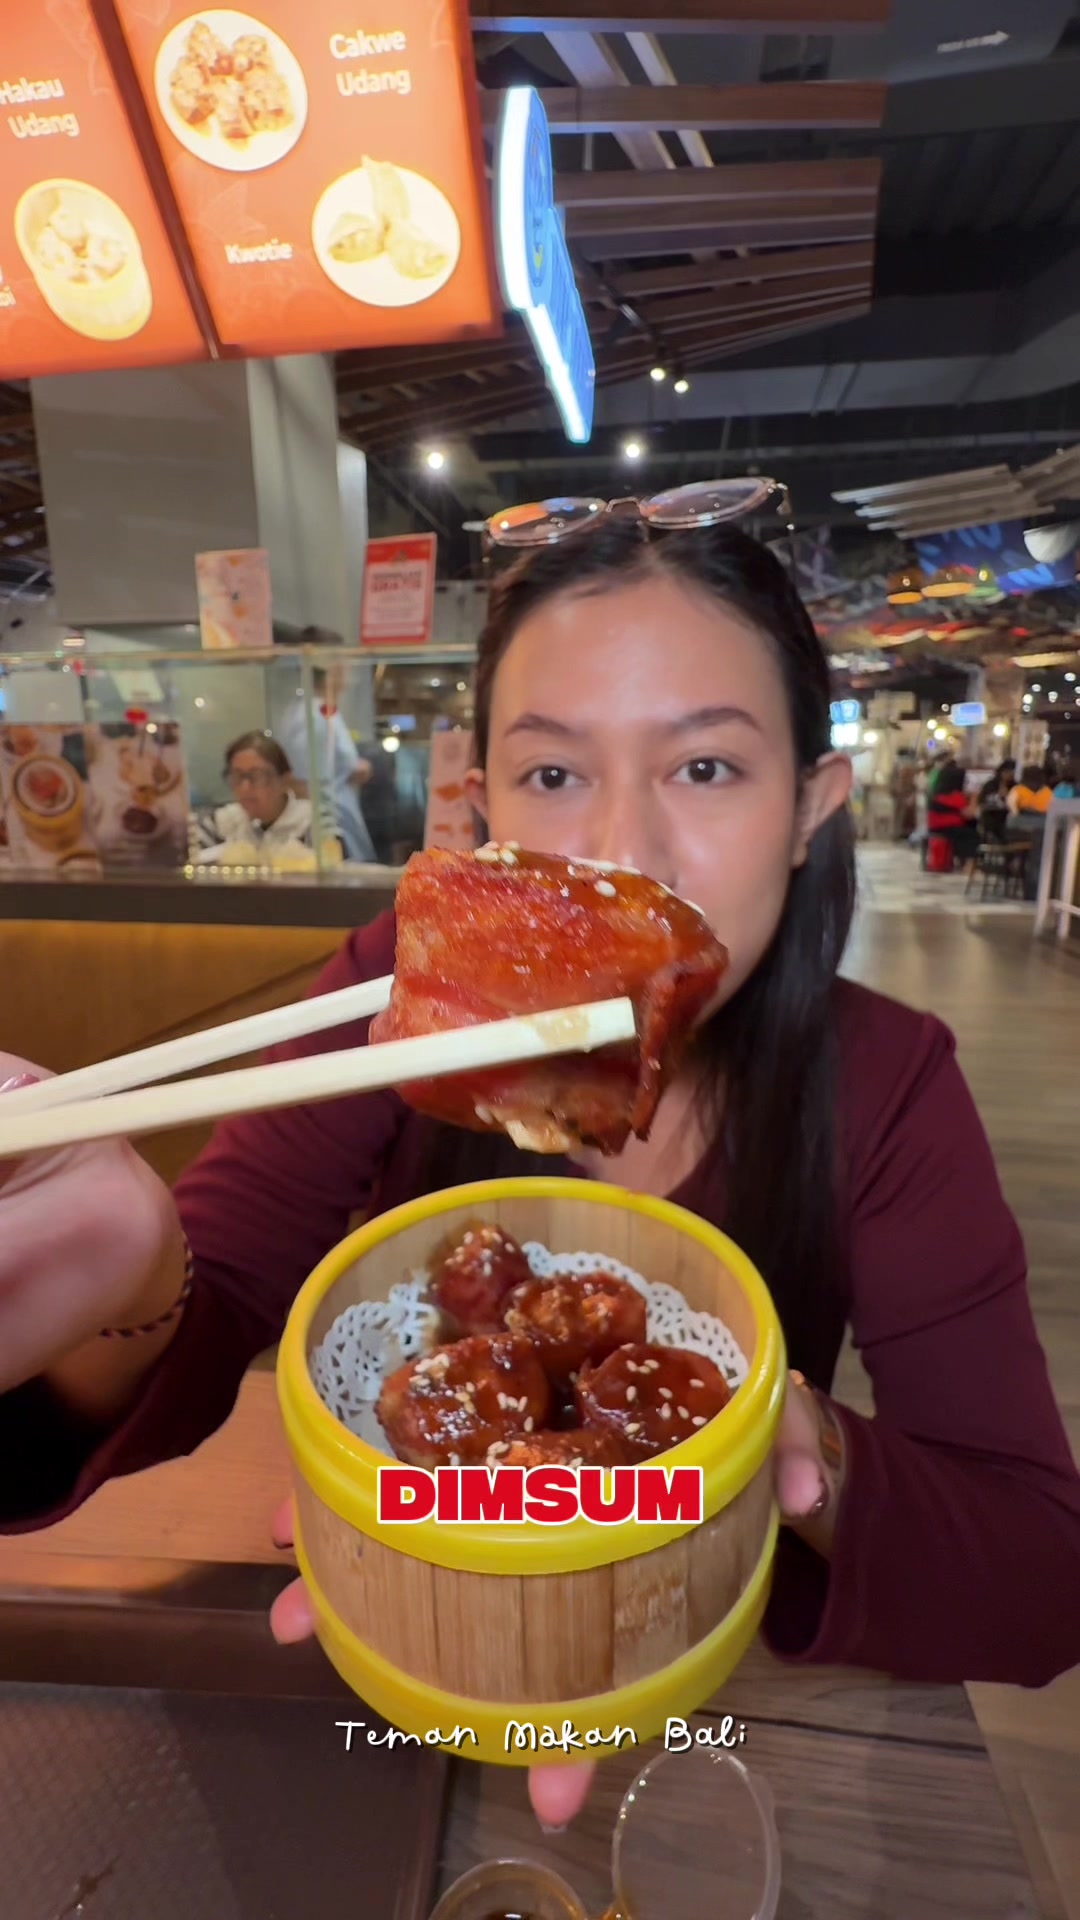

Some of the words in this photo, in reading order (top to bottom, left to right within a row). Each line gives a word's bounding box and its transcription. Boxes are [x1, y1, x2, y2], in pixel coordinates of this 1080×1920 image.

[330, 30, 406, 59] Cakwe
[0, 77, 65, 105] Hakau
[336, 69, 412, 96] Udang
[8, 112, 80, 138] Udang
[224, 239, 293, 264] Kwotie
